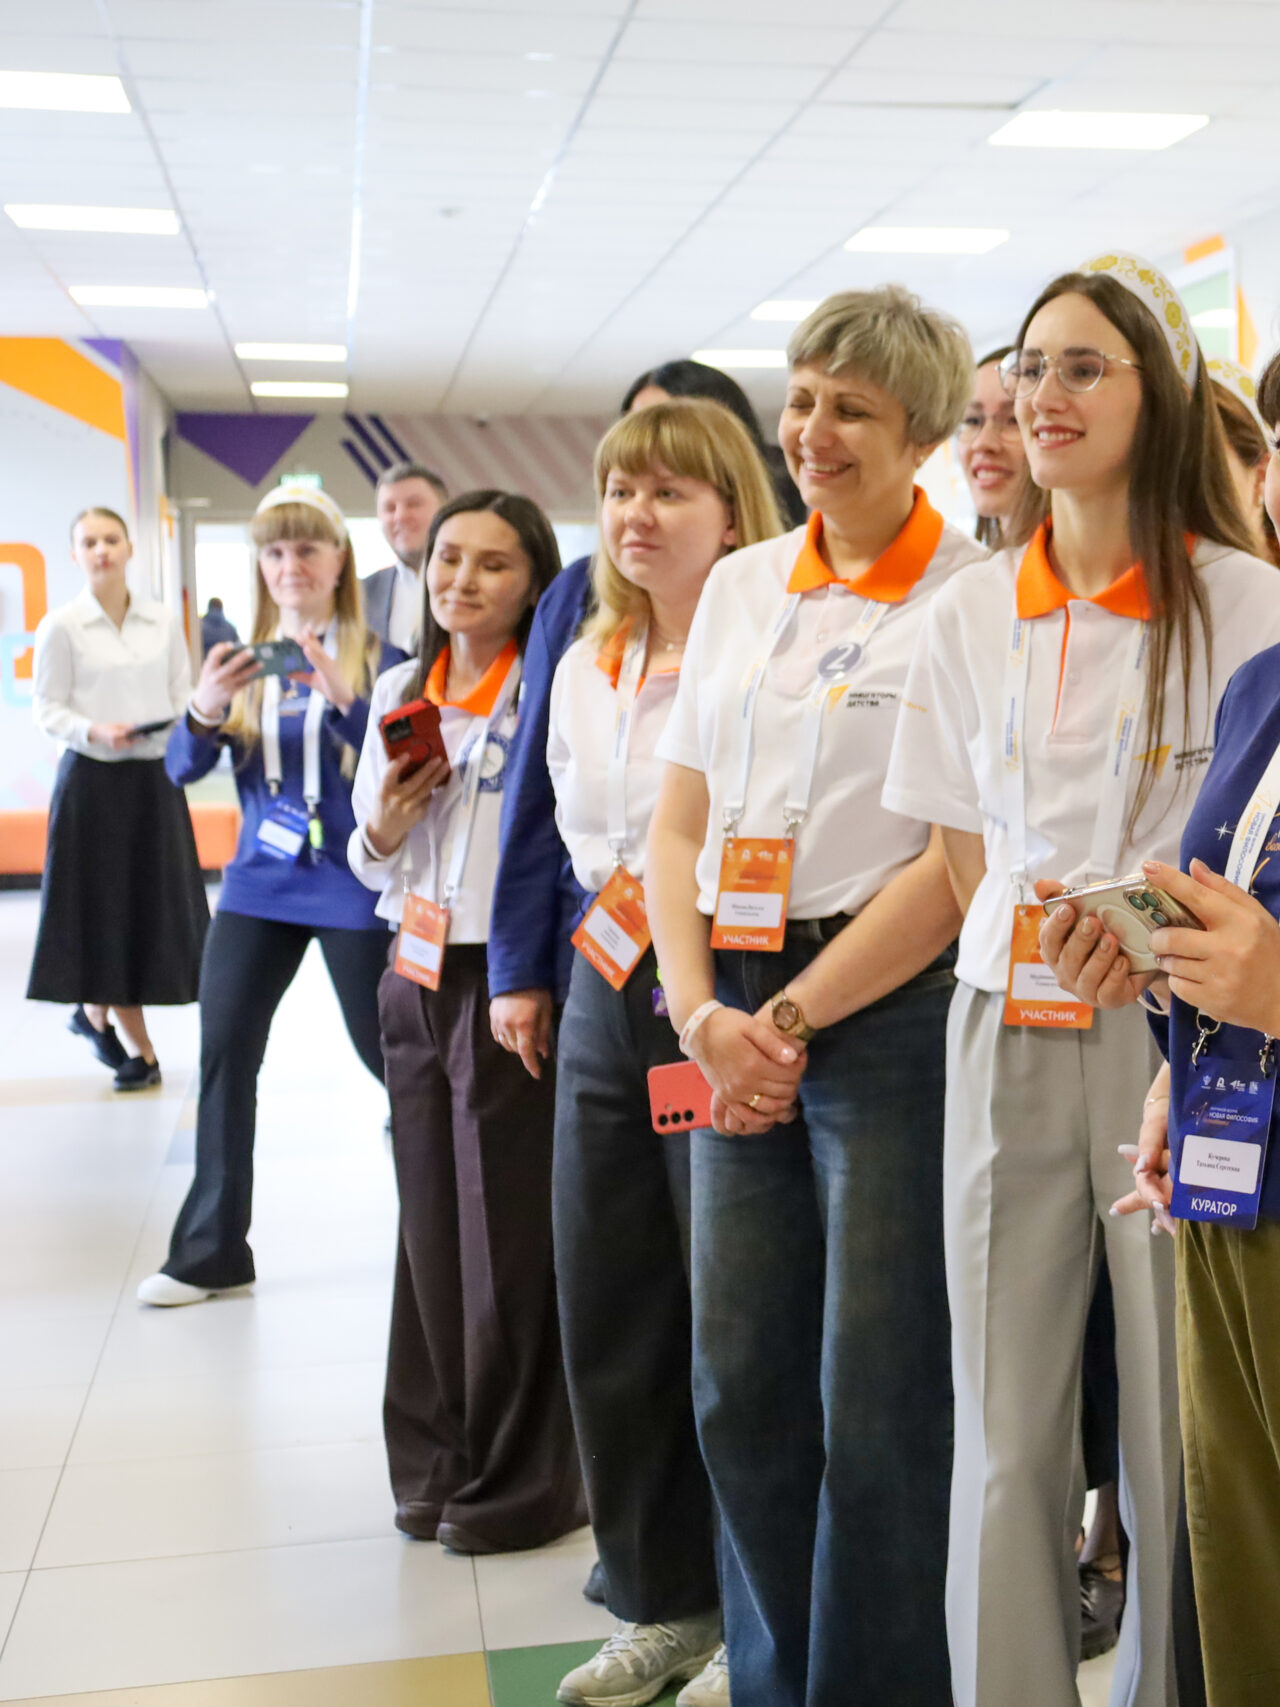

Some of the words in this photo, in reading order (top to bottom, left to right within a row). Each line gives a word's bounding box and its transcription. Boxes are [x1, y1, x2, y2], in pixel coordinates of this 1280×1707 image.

[826, 643, 855, 671] 2
[722, 934, 770, 946] УЧАСТНИК
[1019, 1008, 1077, 1022] УЧАСТНИК
[1208, 1111, 1226, 1120] НОВАЯ
[1191, 1197, 1237, 1216] КУРАТОР
